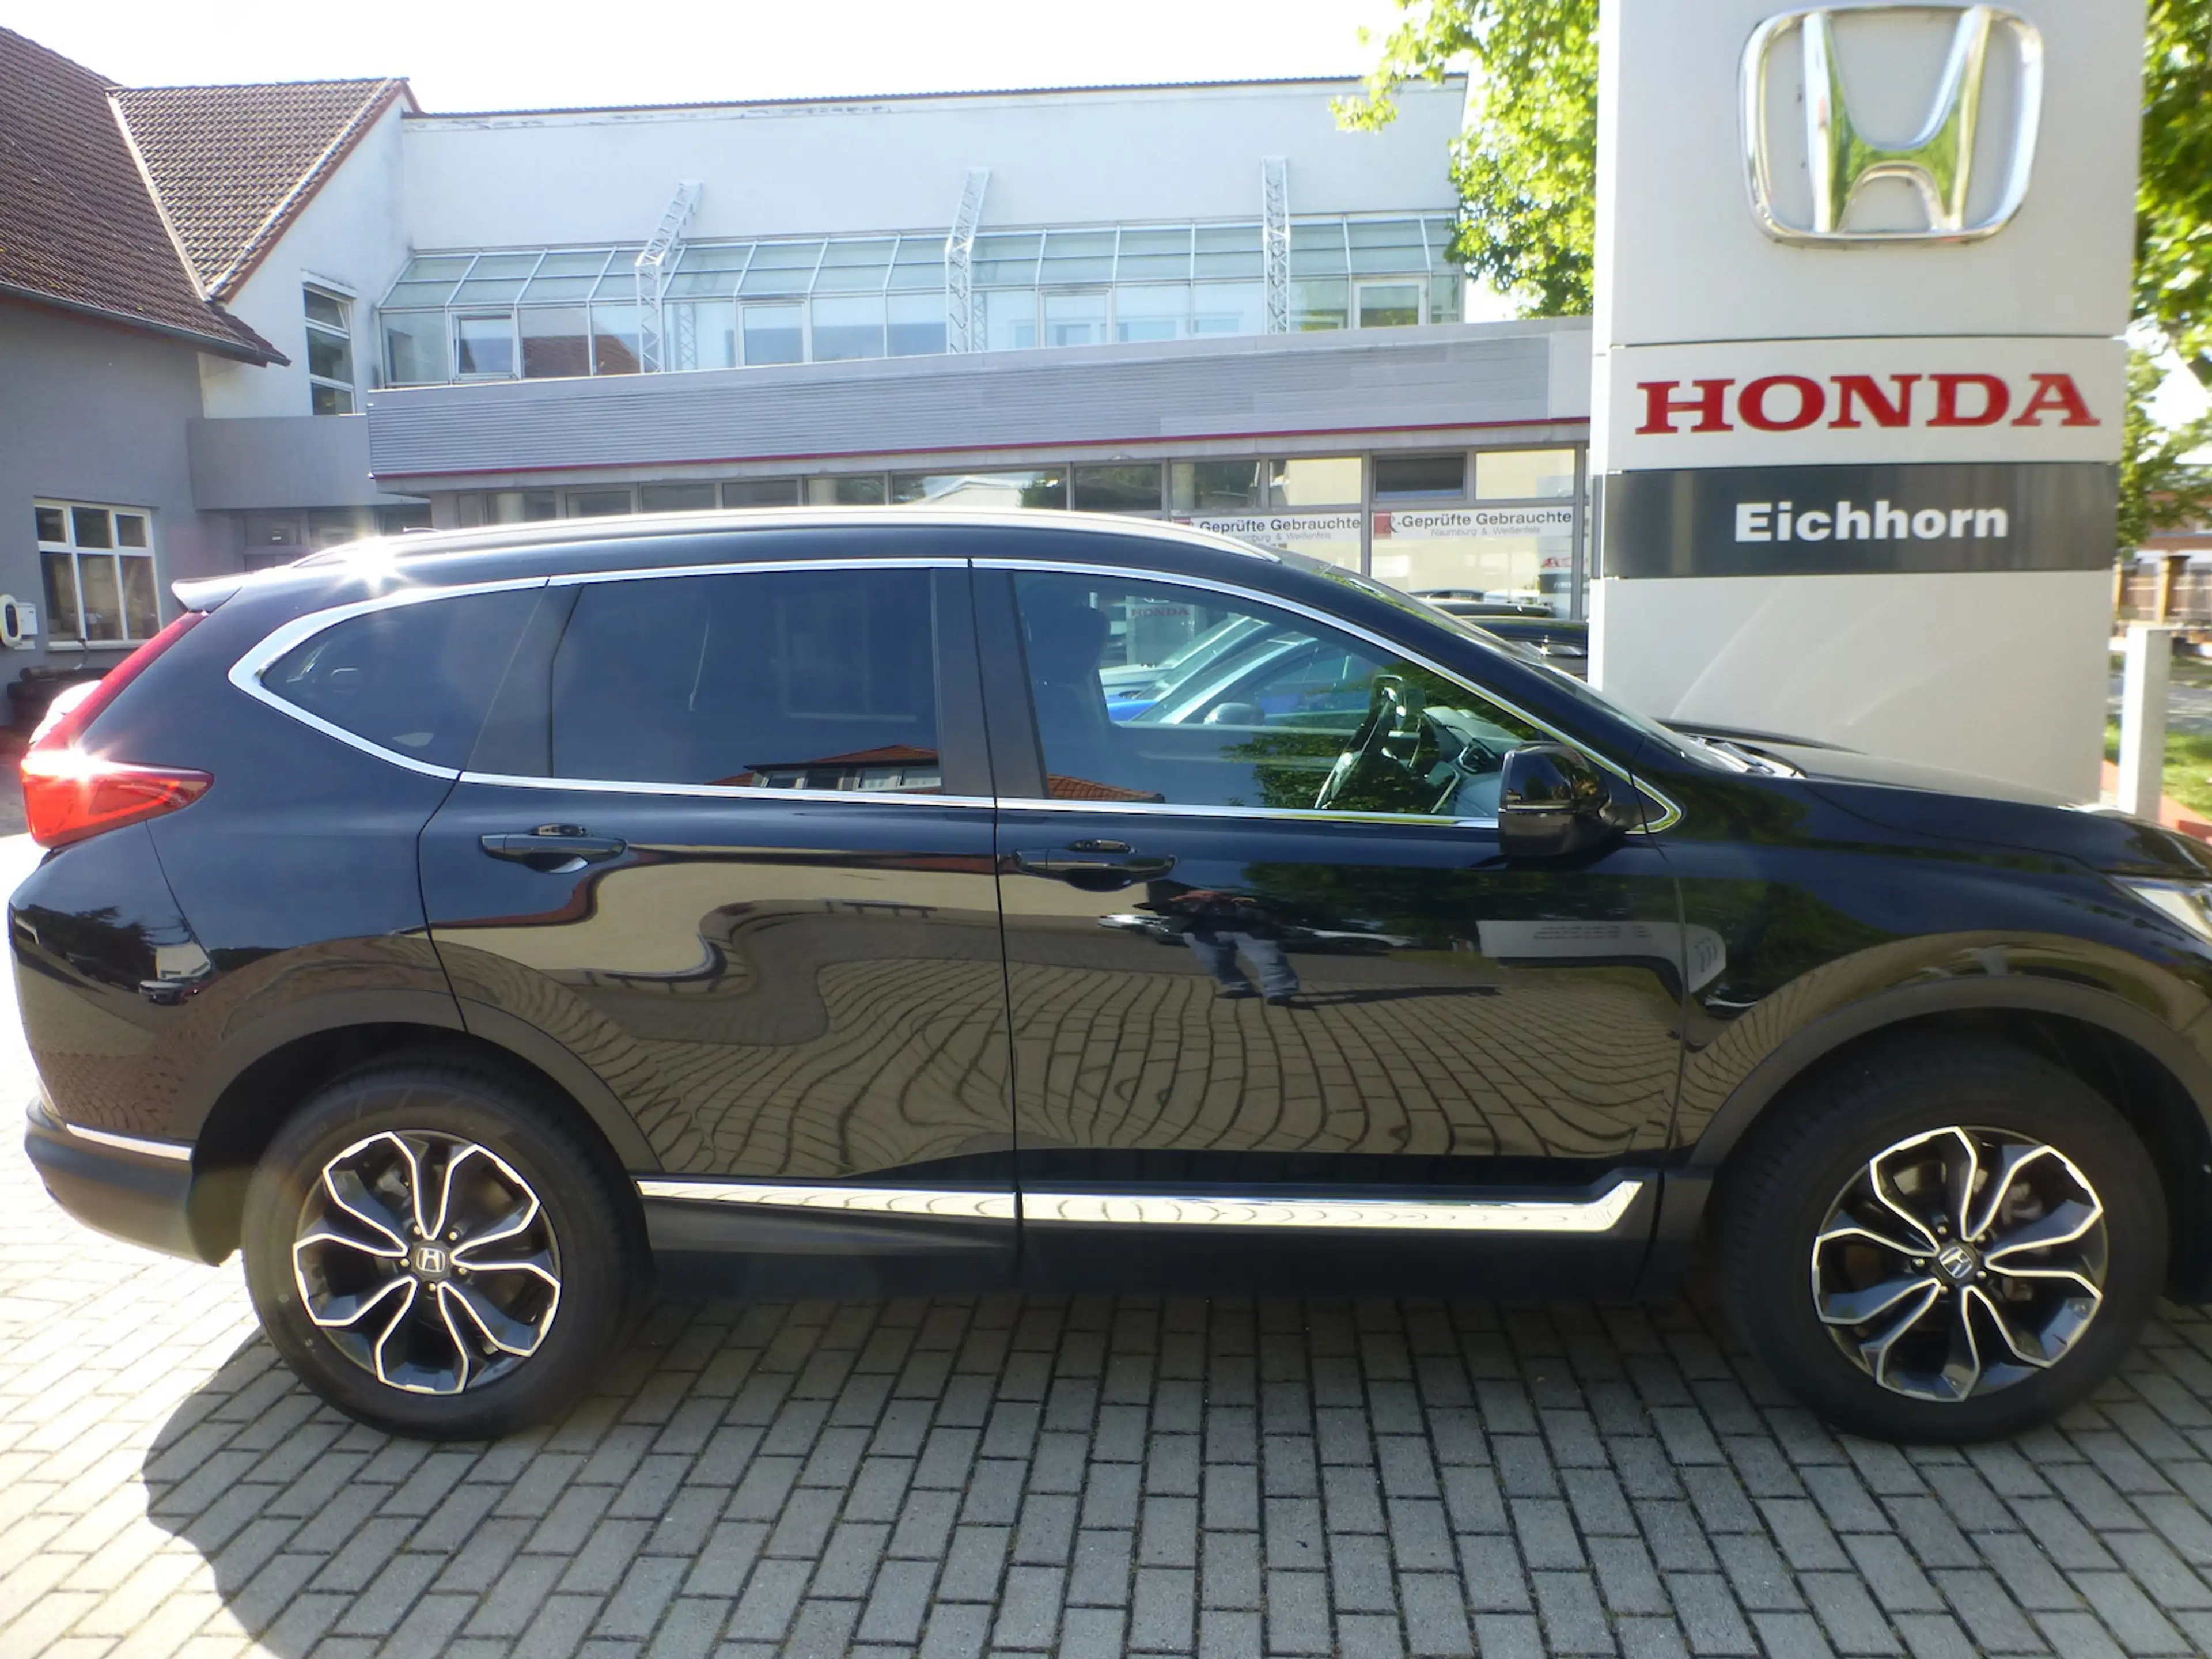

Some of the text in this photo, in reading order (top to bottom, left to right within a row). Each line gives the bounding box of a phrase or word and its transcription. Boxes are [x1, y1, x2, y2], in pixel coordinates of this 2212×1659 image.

[1635, 373, 2101, 435] HONDA
[1200, 517, 1360, 534] Geprüfte Gebrauchte
[1476, 512, 1571, 525] Gebrauchte
[1735, 500, 2008, 542] Eichhorn
[1482, 527, 1487, 536] &
[1130, 607, 1190, 617] HONDA
